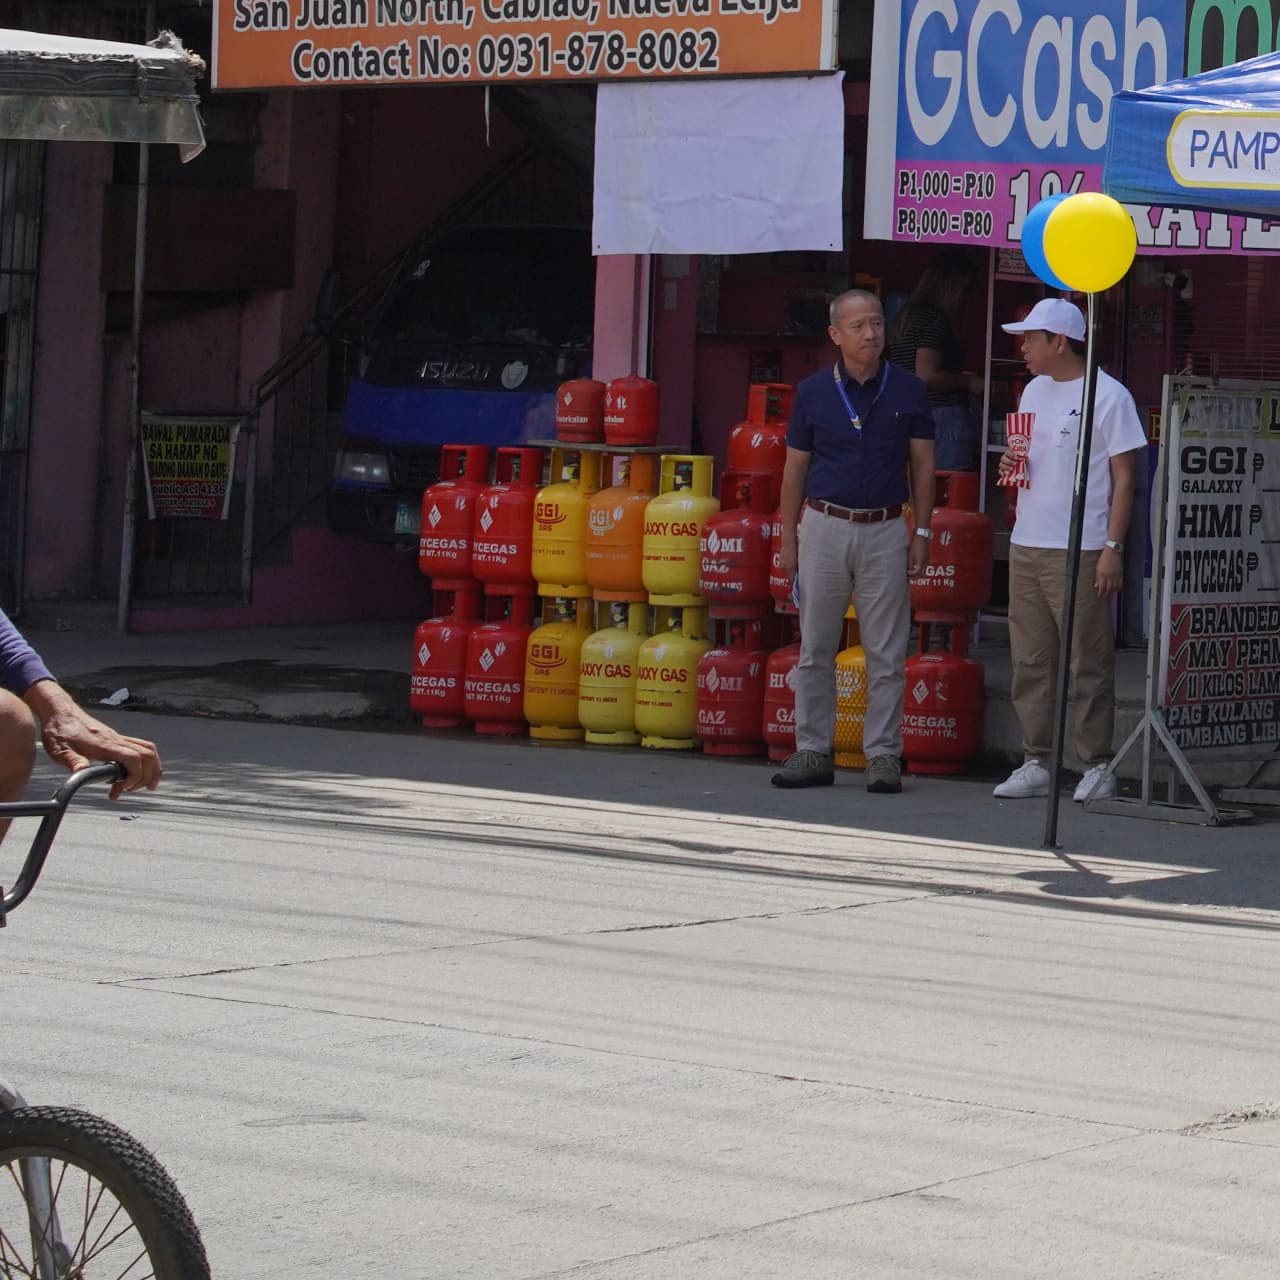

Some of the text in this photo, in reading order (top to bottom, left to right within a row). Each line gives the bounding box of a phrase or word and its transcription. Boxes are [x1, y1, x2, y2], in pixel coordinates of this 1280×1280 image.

[292, 30, 720, 81] Contact No: 0931-878-8082
[898, 170, 949, 202] P1,000
[964, 171, 995, 198] P10
[897, 208, 948, 241] P8,000
[962, 211, 993, 237] P80
[149, 443, 218, 460] SA HARAP NG
[1180, 445, 1248, 475] GGI
[1181, 479, 1243, 494] GALAXXY
[670, 522, 698, 537] GAS
[1177, 504, 1243, 538] HIMI
[1173, 549, 1244, 595] PRYCEGAS
[531, 644, 560, 660] GGI
[1187, 639, 1232, 669] MAY
[604, 663, 632, 679] GAS
[660, 667, 688, 683] GAS
[1201, 671, 1245, 699] KILOS
[1167, 705, 1202, 727] PAG
[1207, 701, 1274, 723] KULANG
[1169, 722, 1247, 747] TIMBANG
